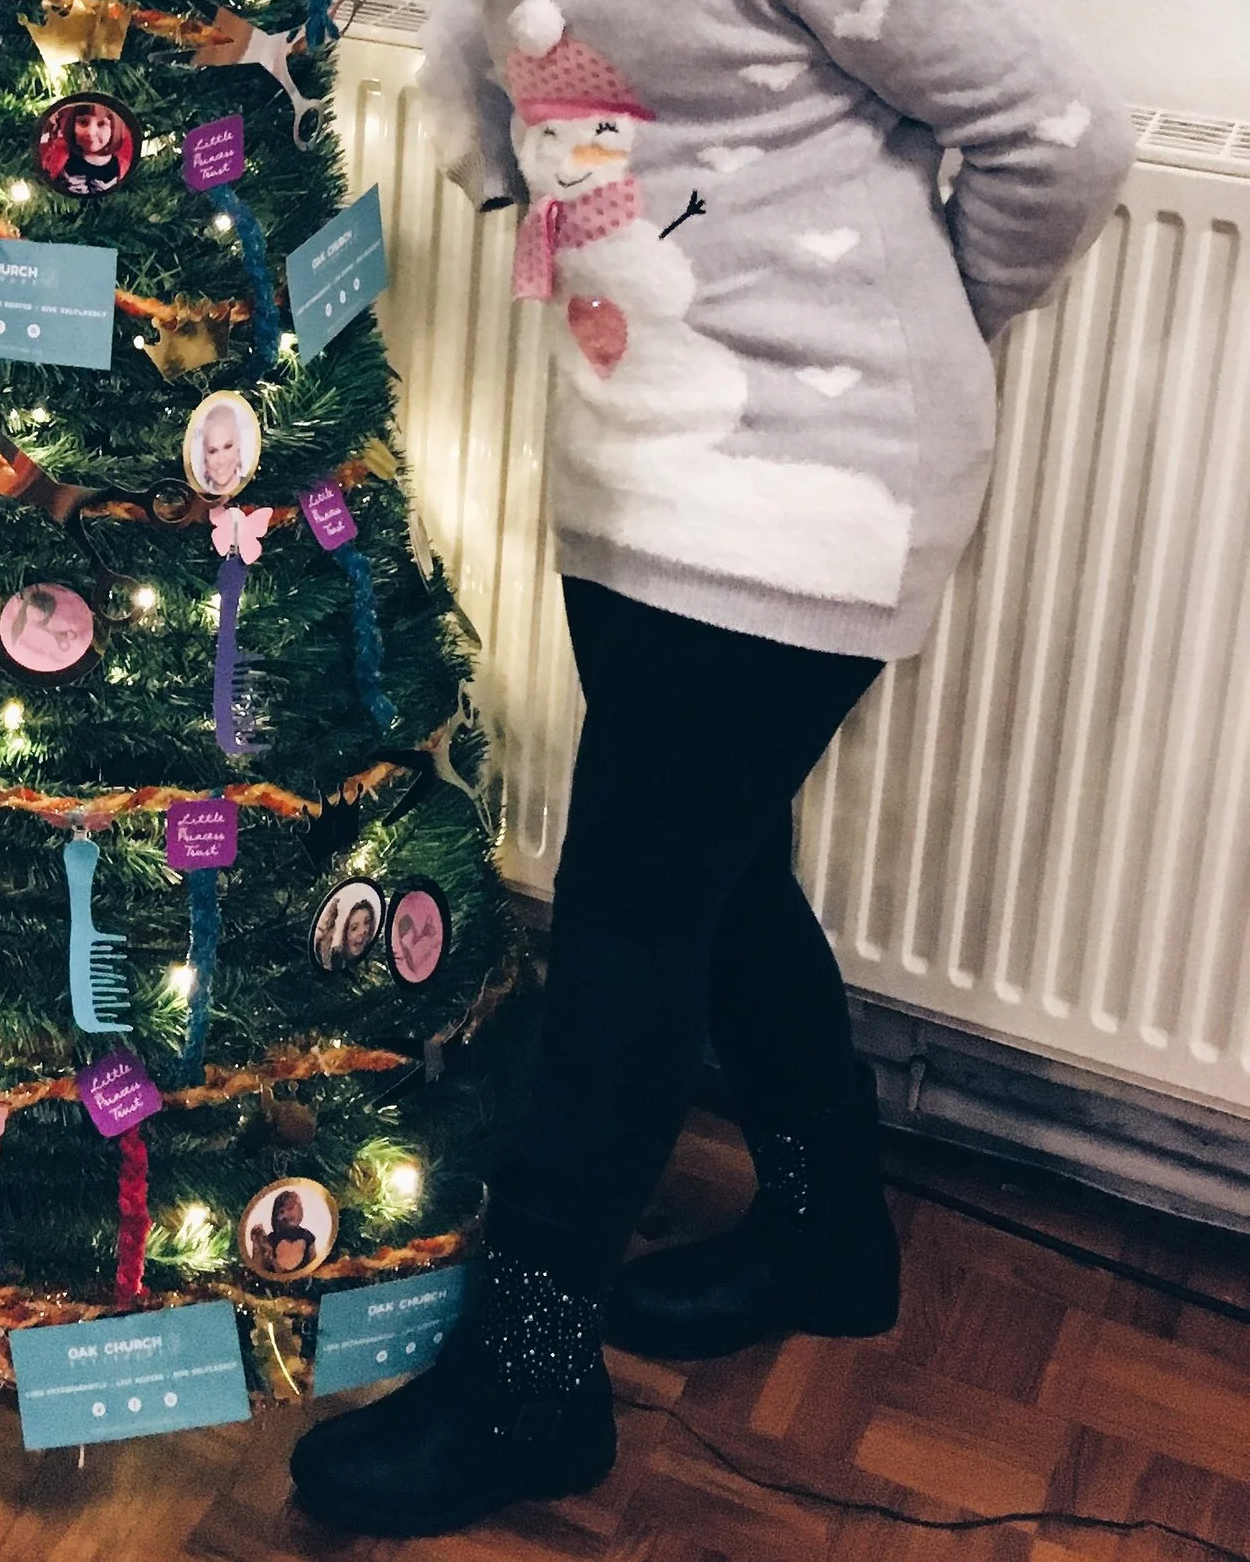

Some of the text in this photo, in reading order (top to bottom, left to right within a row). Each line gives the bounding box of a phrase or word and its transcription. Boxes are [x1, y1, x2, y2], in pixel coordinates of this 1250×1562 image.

[194, 130, 234, 151] Little
[193, 149, 235, 168] Princess
[199, 163, 230, 180] Trust
[177, 811, 225, 826] Little
[177, 827, 225, 842] Princess
[184, 844, 219, 857] Trust
[90, 1063, 133, 1094] Little
[94, 1082, 141, 1111] Princess
[109, 1097, 144, 1121] Trust
[368, 1289, 447, 1316] OAK CHURCH
[68, 1336, 162, 1360] OAK CHURCH
